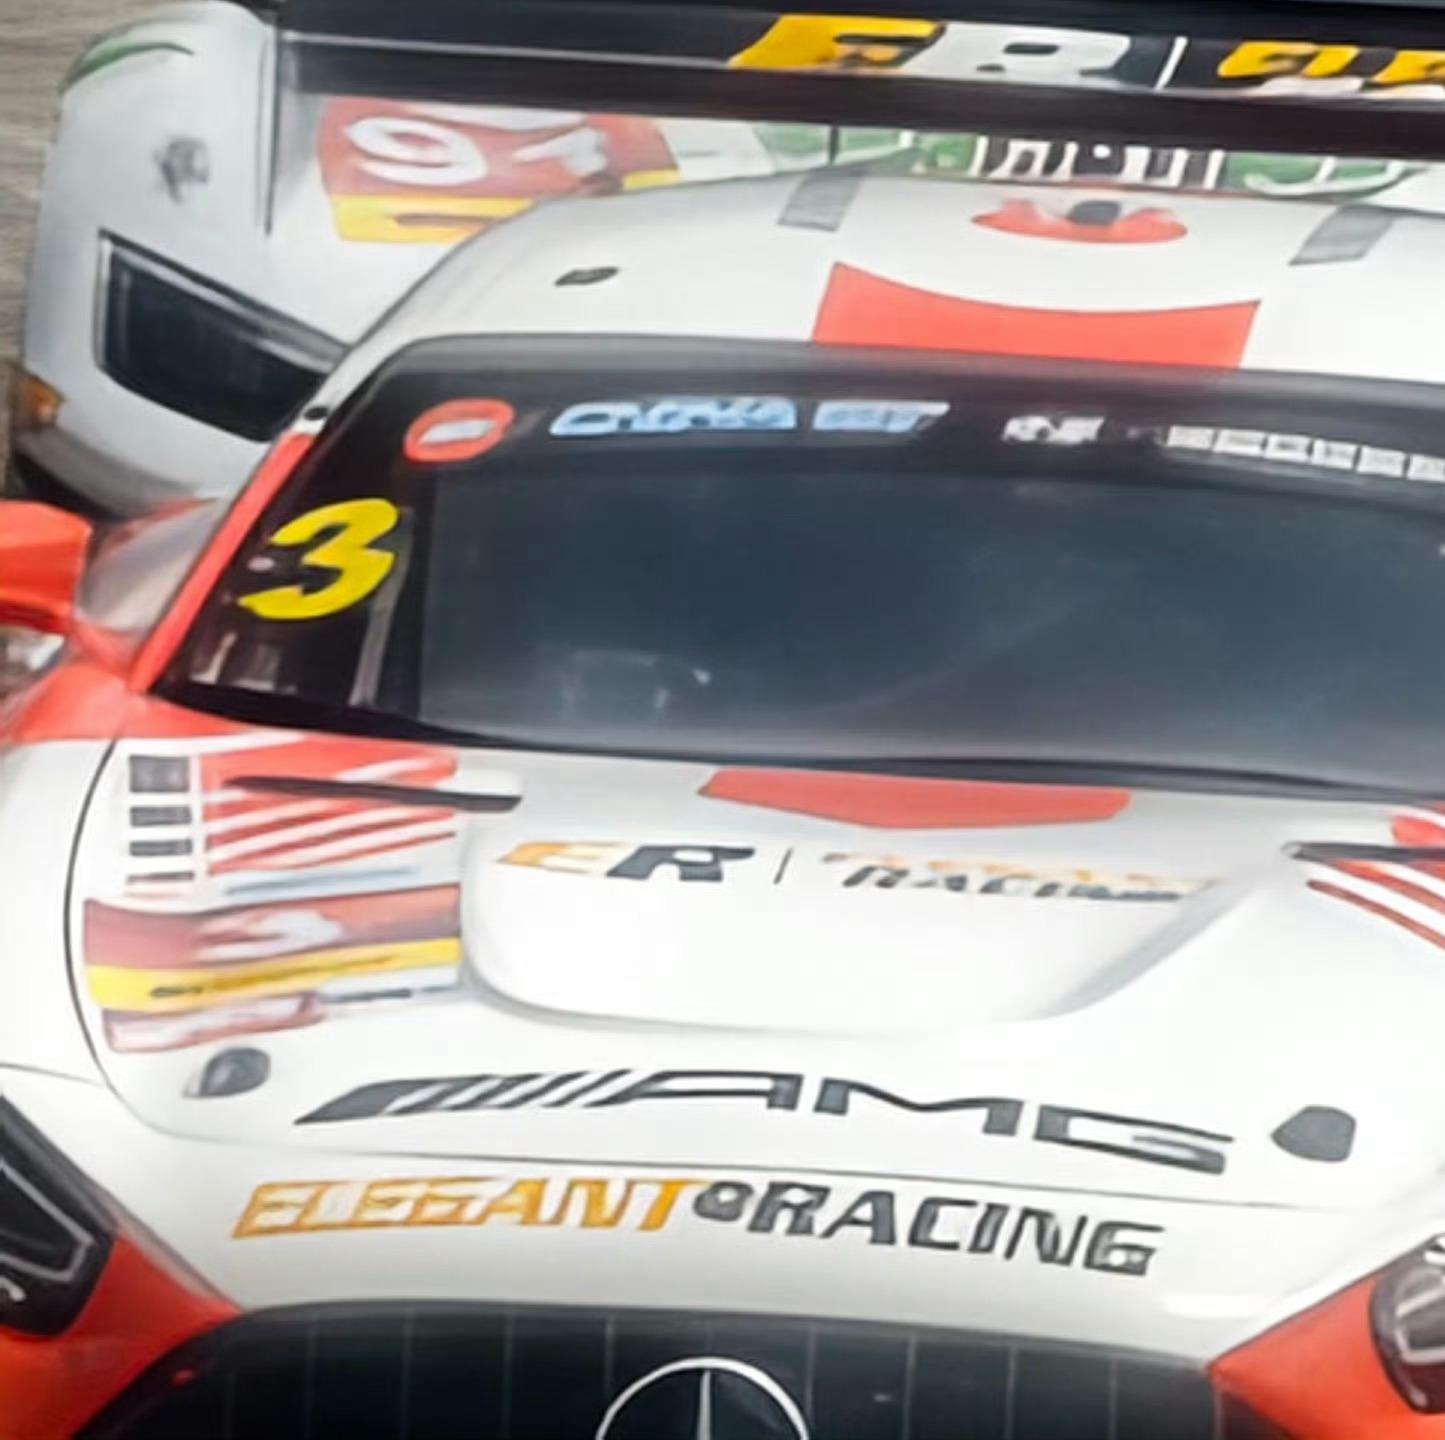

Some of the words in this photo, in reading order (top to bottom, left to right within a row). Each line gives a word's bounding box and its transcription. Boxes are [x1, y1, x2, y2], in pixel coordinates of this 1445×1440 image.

[237, 497, 400, 621] 3
[598, 1068, 1235, 1176] AMG
[231, 1174, 715, 1241] ELEGANT
[745, 1182, 1167, 1277] RACING
